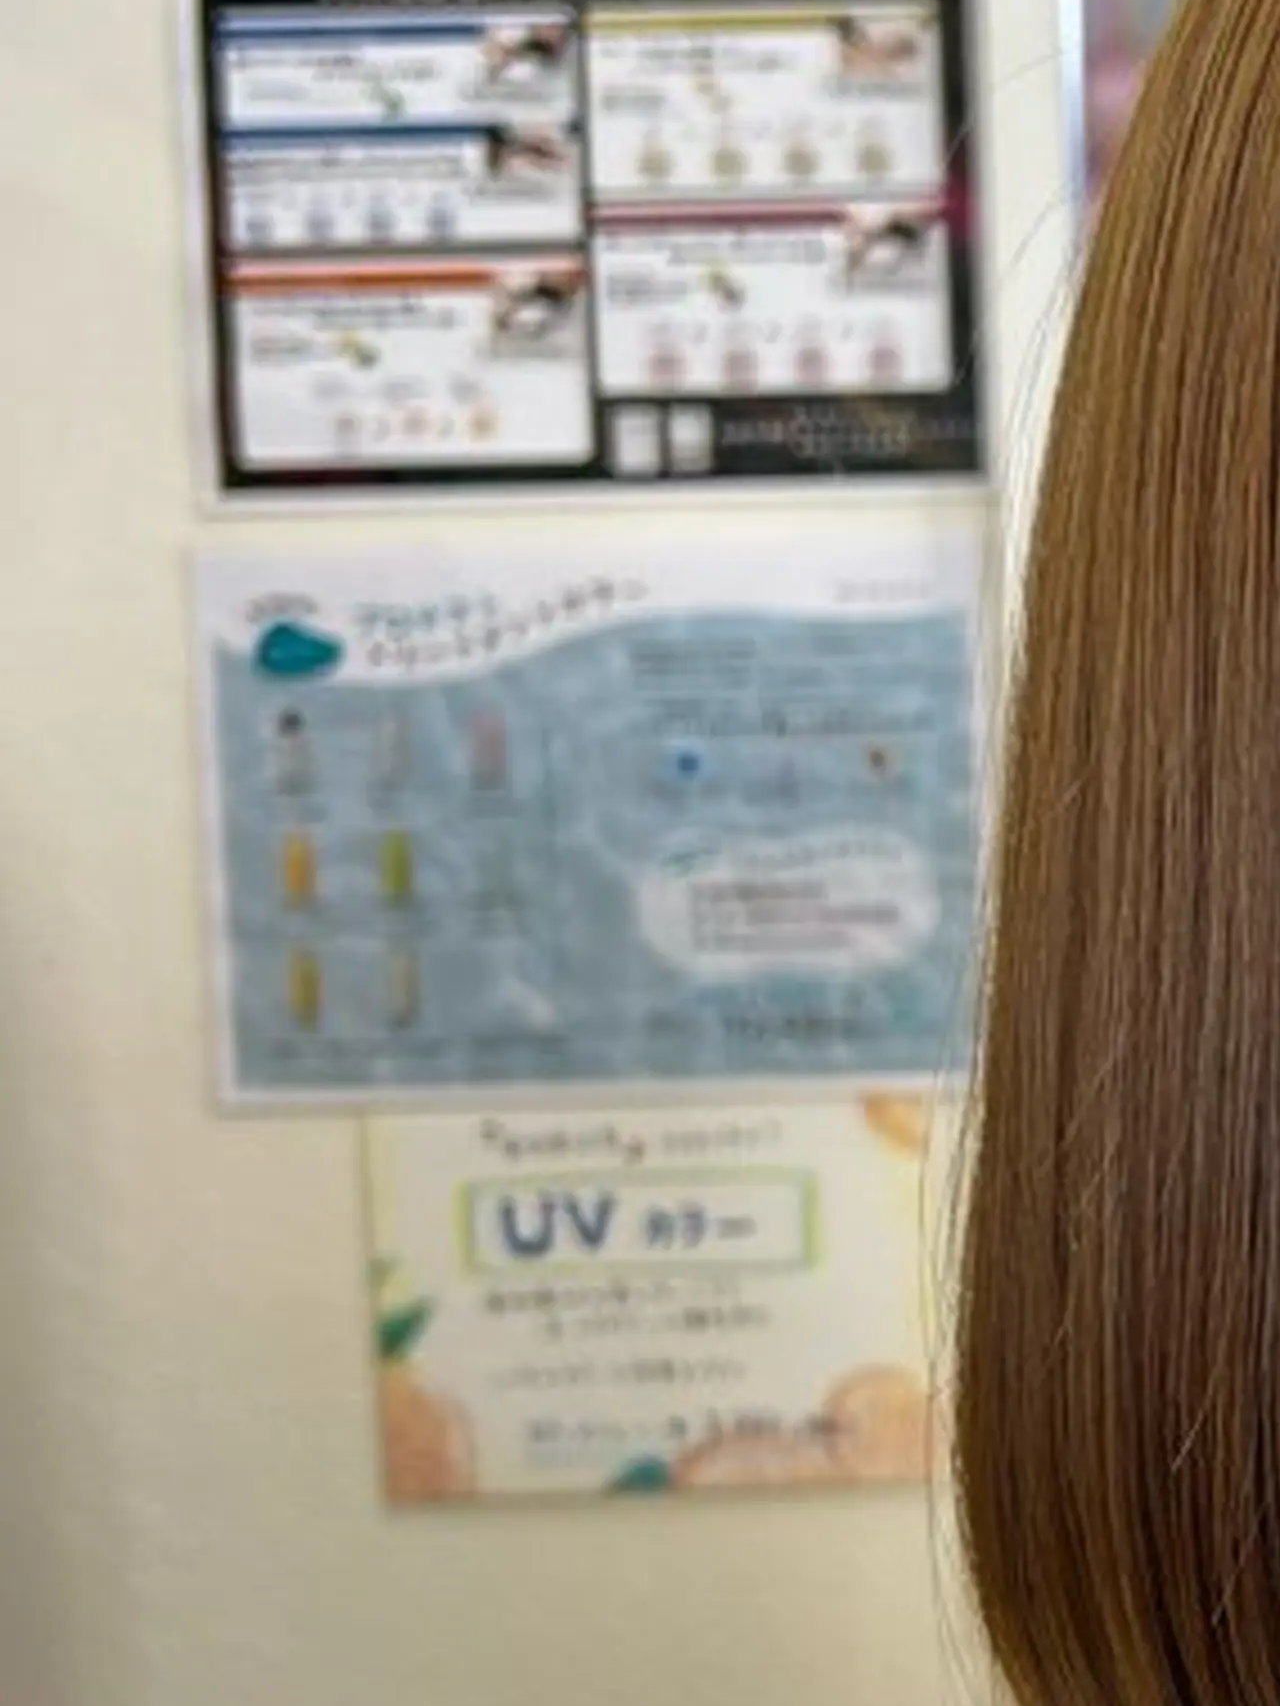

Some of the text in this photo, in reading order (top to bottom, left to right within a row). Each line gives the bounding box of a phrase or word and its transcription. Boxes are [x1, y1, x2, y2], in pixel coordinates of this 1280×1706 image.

[501, 1188, 759, 1259] UV カラー
